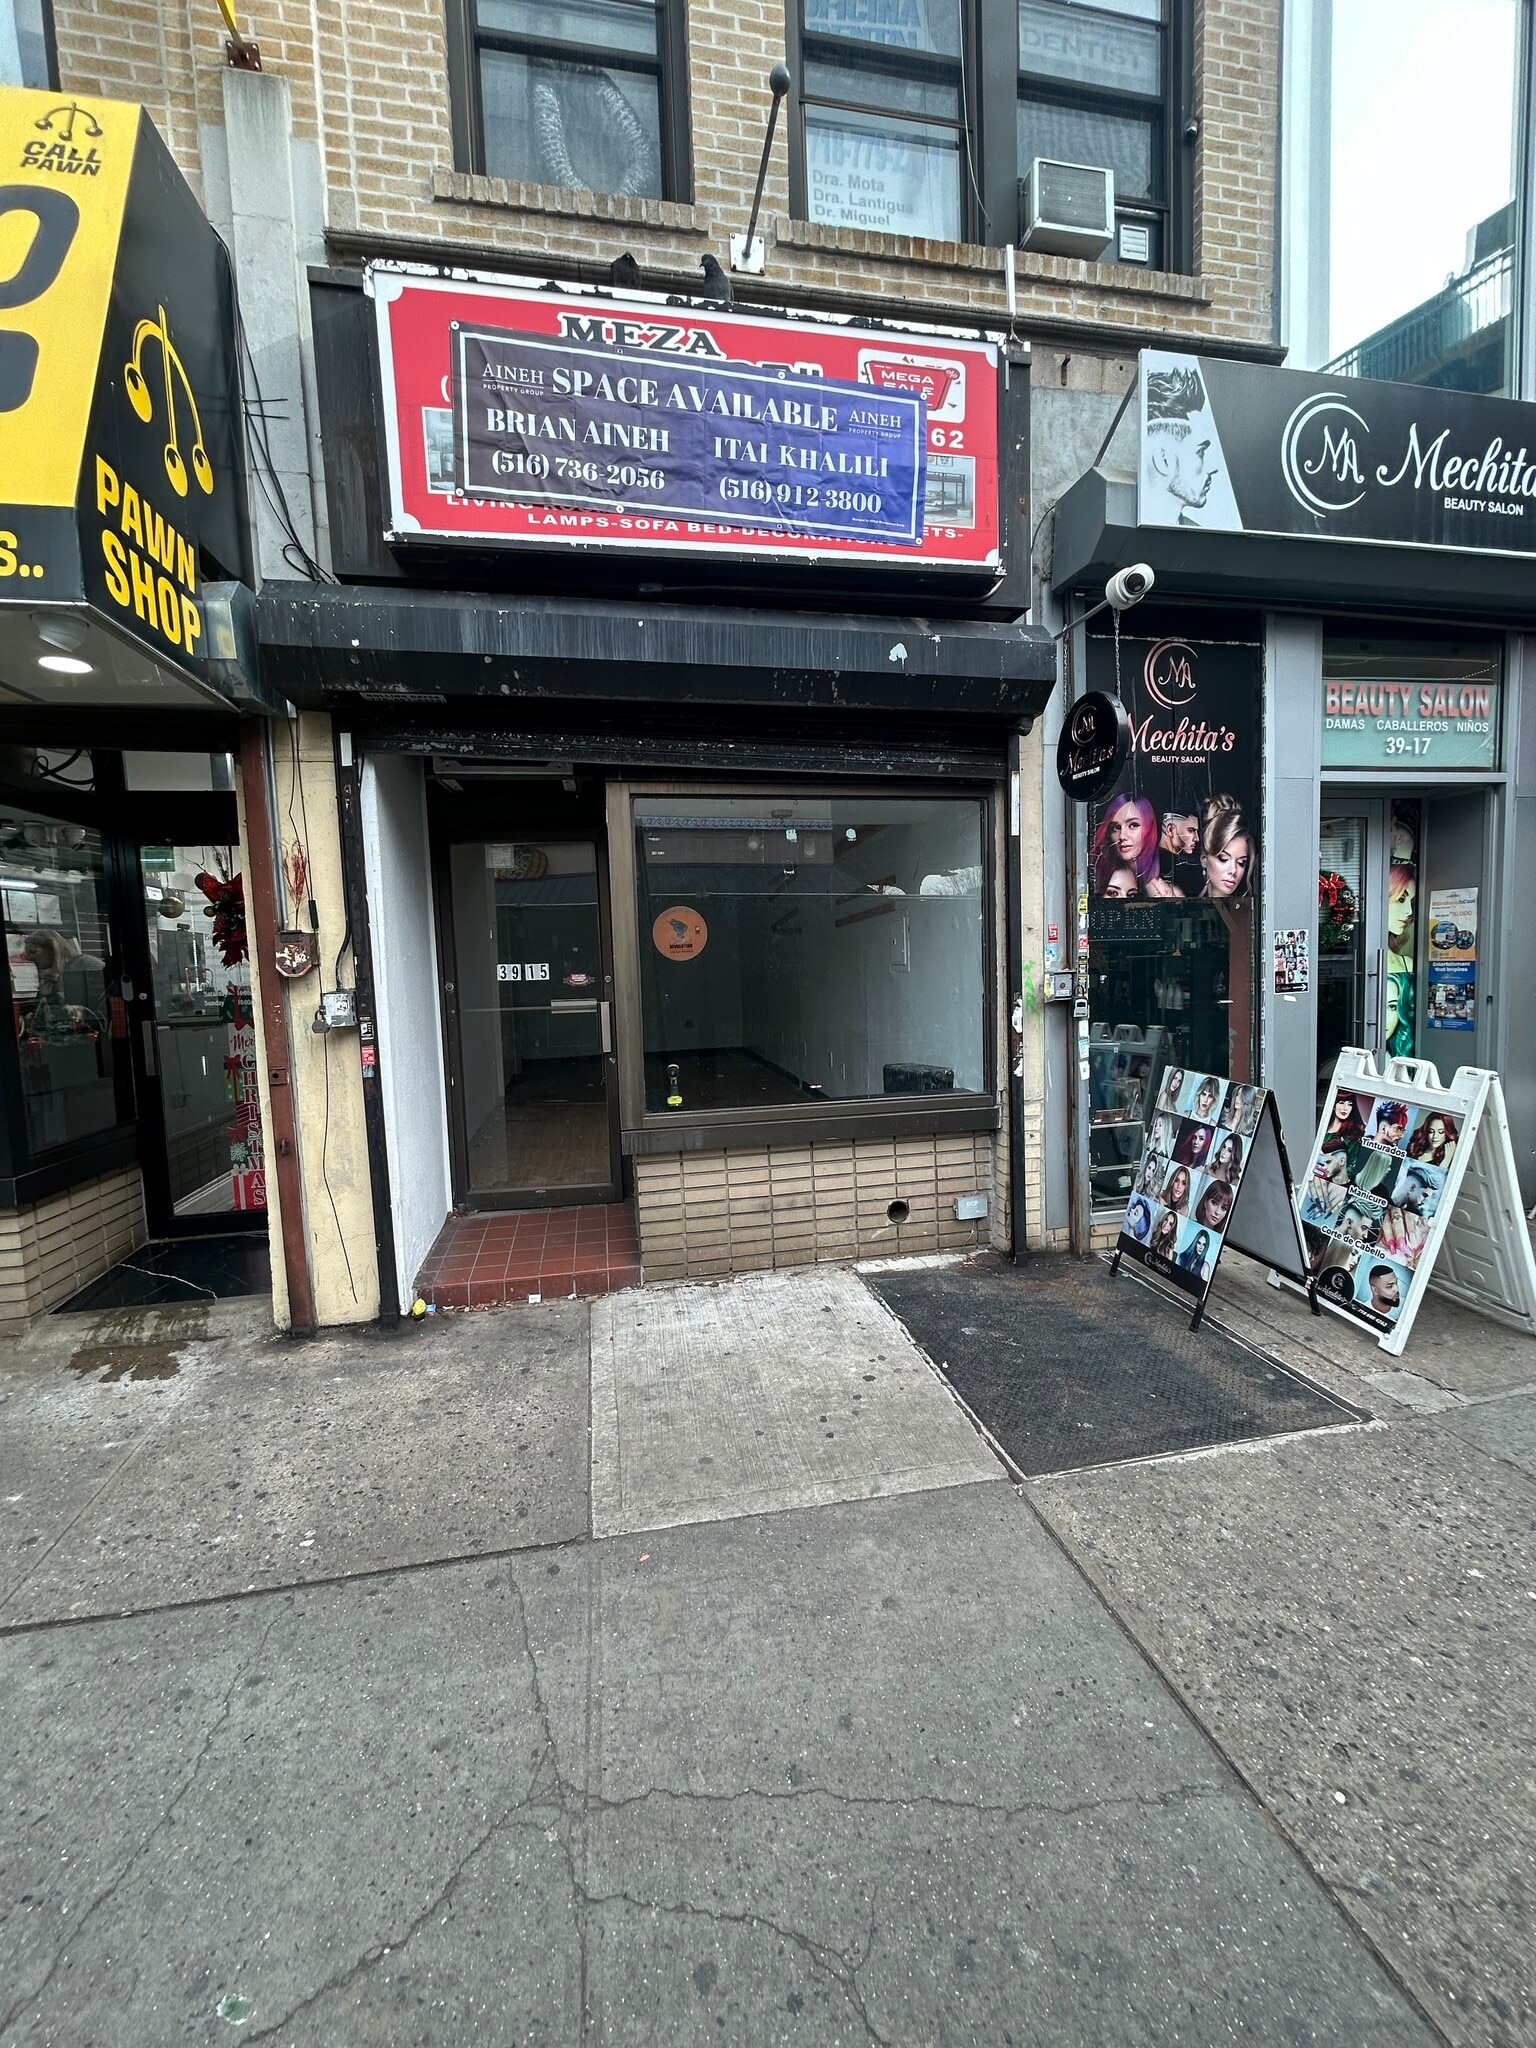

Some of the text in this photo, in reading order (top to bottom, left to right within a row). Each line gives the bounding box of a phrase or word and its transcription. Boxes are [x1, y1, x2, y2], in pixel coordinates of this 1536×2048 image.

[1022, 28, 1141, 70] DENTIST
[23, 140, 102, 164] CALL
[20, 156, 100, 176] PAWN
[813, 169, 885, 192] Dra. Mota
[813, 187, 914, 214] Dra. Lantigua
[815, 204, 836, 218] Dr.
[841, 208, 890, 226] Miguel
[560, 314, 726, 358] MEZA
[482, 362, 544, 385] AINEH
[881, 370, 935, 385] MEGA
[483, 383, 544, 397] PROPERTY GROUP
[552, 367, 838, 432] SPACE AVAILABLE
[486, 407, 670, 453] BRIAN AINEH
[848, 409, 901, 428] AINEH
[849, 427, 901, 439] PROPERTY GROUP
[714, 437, 888, 478] ITAI KHALILI
[492, 450, 666, 490] (516) 736-2056
[719, 476, 882, 514] (516) 912-3800
[1444, 496, 1524, 516] BEAUTY SALON
[96, 454, 196, 594] PAWN
[102, 529, 201, 656] SHOP
[1326, 681, 1491, 718] BEAUTY SALON
[1326, 718, 1489, 732] DAMAS CABALLEROS NIÑOS
[1385, 736, 1432, 754] 39-17
[1151, 755, 1205, 764] BEAUTY SALON
[230, 1033, 256, 1052] Mer
[1361, 1136, 1406, 1158] Tinturados
[1348, 1186, 1387, 1207] Manicure
[1321, 1225, 1386, 1260] Corte de Cabello
